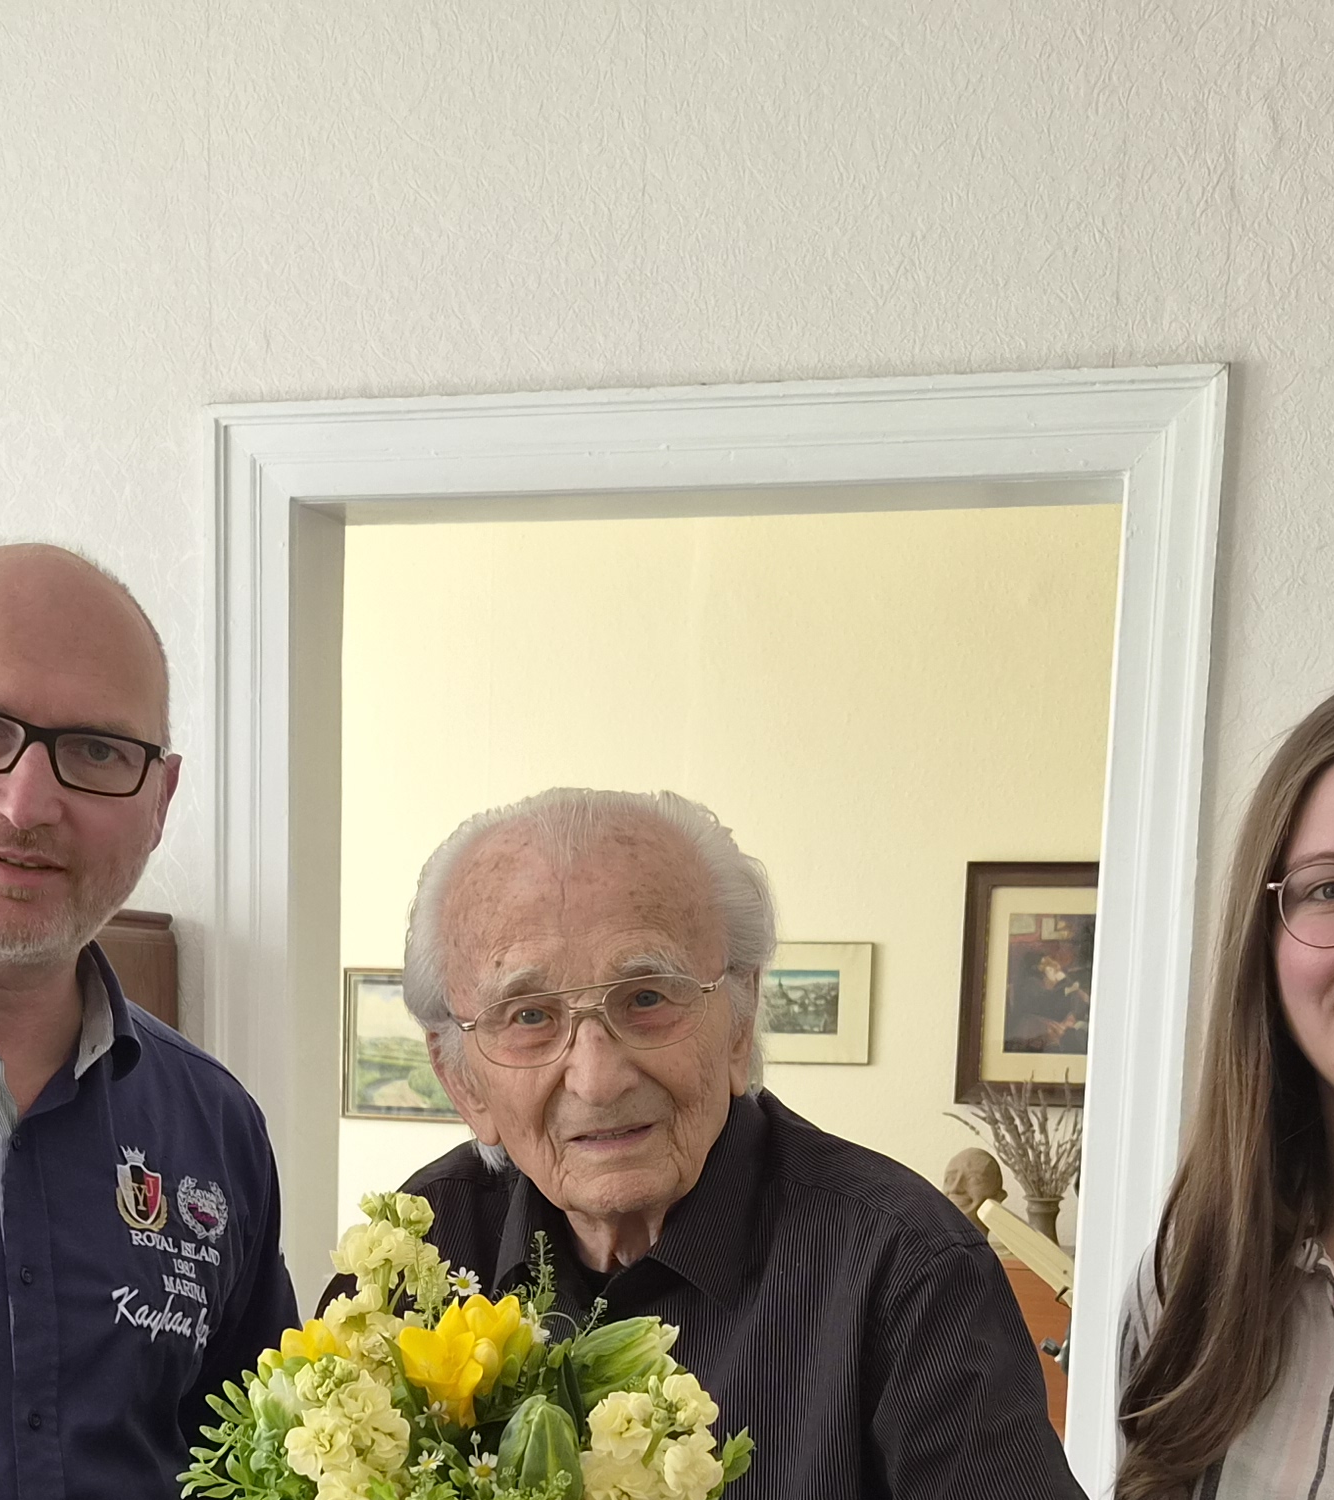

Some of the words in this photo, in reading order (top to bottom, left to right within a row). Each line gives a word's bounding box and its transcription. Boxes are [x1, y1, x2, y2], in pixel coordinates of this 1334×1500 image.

[129, 1229, 178, 1253] ROYAL
[162, 1275, 208, 1305] MARINA
[111, 1286, 192, 1343] Kayhan
